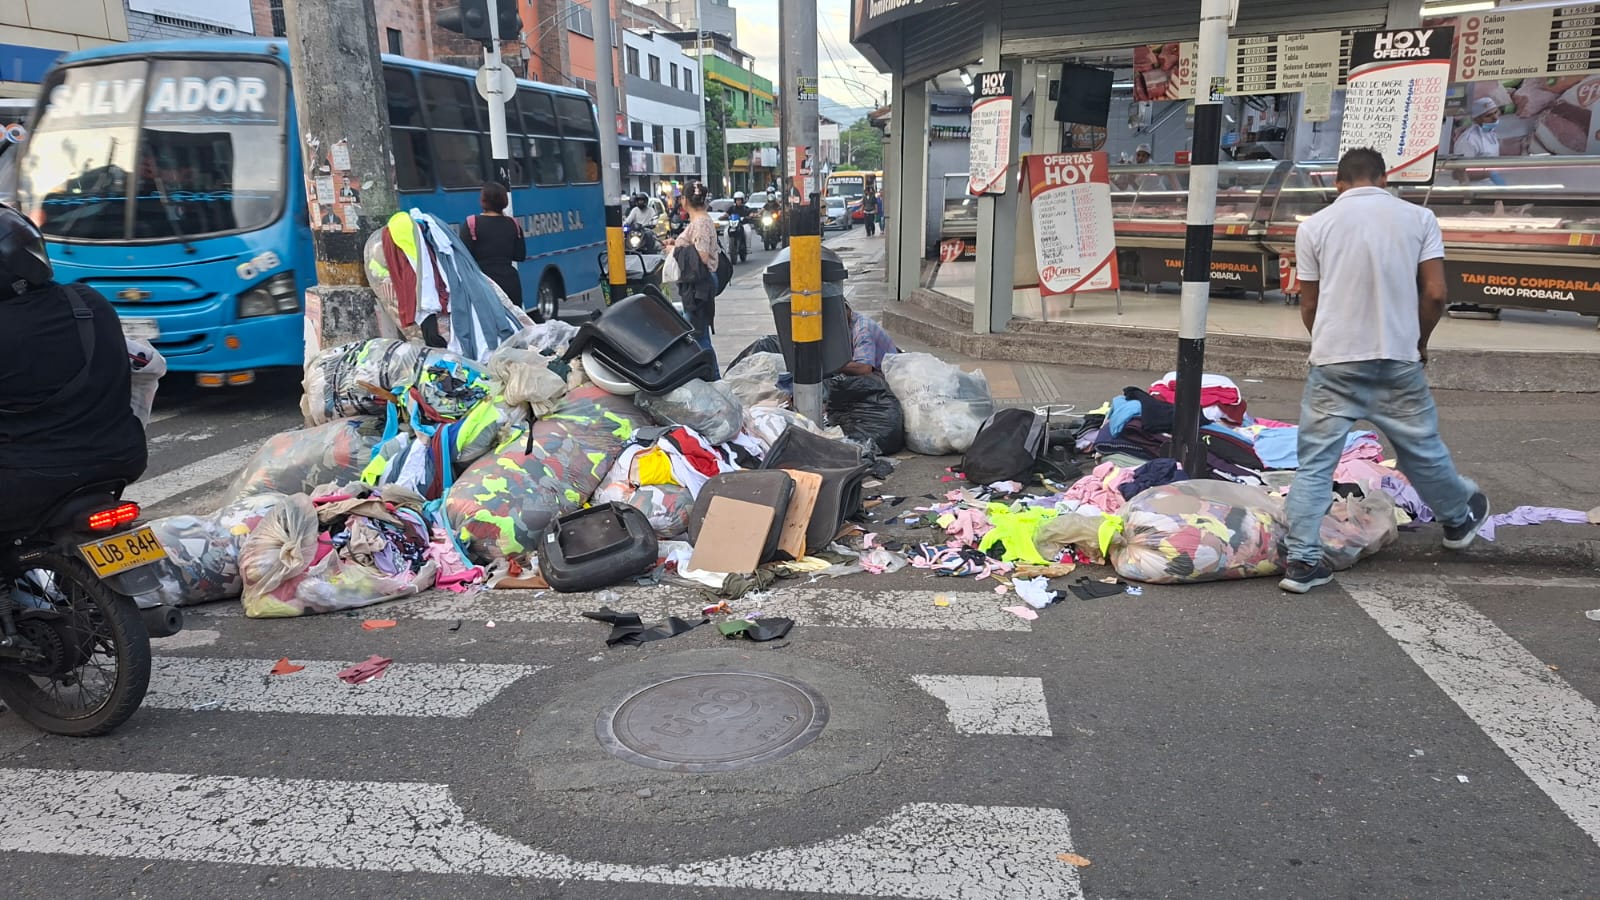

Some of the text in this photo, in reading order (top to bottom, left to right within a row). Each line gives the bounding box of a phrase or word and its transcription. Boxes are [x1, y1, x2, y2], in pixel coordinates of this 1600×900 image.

[1482, 27, 1504, 36] Pierna
[1374, 29, 1433, 50] HOY
[1482, 38, 1505, 46] Tocino
[1373, 47, 1430, 59] OFERTAS
[1462, 17, 1480, 79] cerdo
[1480, 47, 1506, 57] Costilla
[1479, 59, 1505, 67] Chuleta
[1180, 58, 1190, 86] res
[1478, 66, 1538, 77] Pierna Económica
[982, 72, 1006, 88] HOY
[1043, 154, 1093, 166] OFERTAS
[1044, 164, 1095, 185] HOY
[1056, 266, 1081, 276] Carnes
[1164, 259, 1258, 273] TAN OMPRARLA
[1461, 273, 1600, 292] TAN RICO COMPRARLA
[1483, 285, 1575, 301] COMO PROBARLA
[87, 532, 160, 568] LUB 84H
